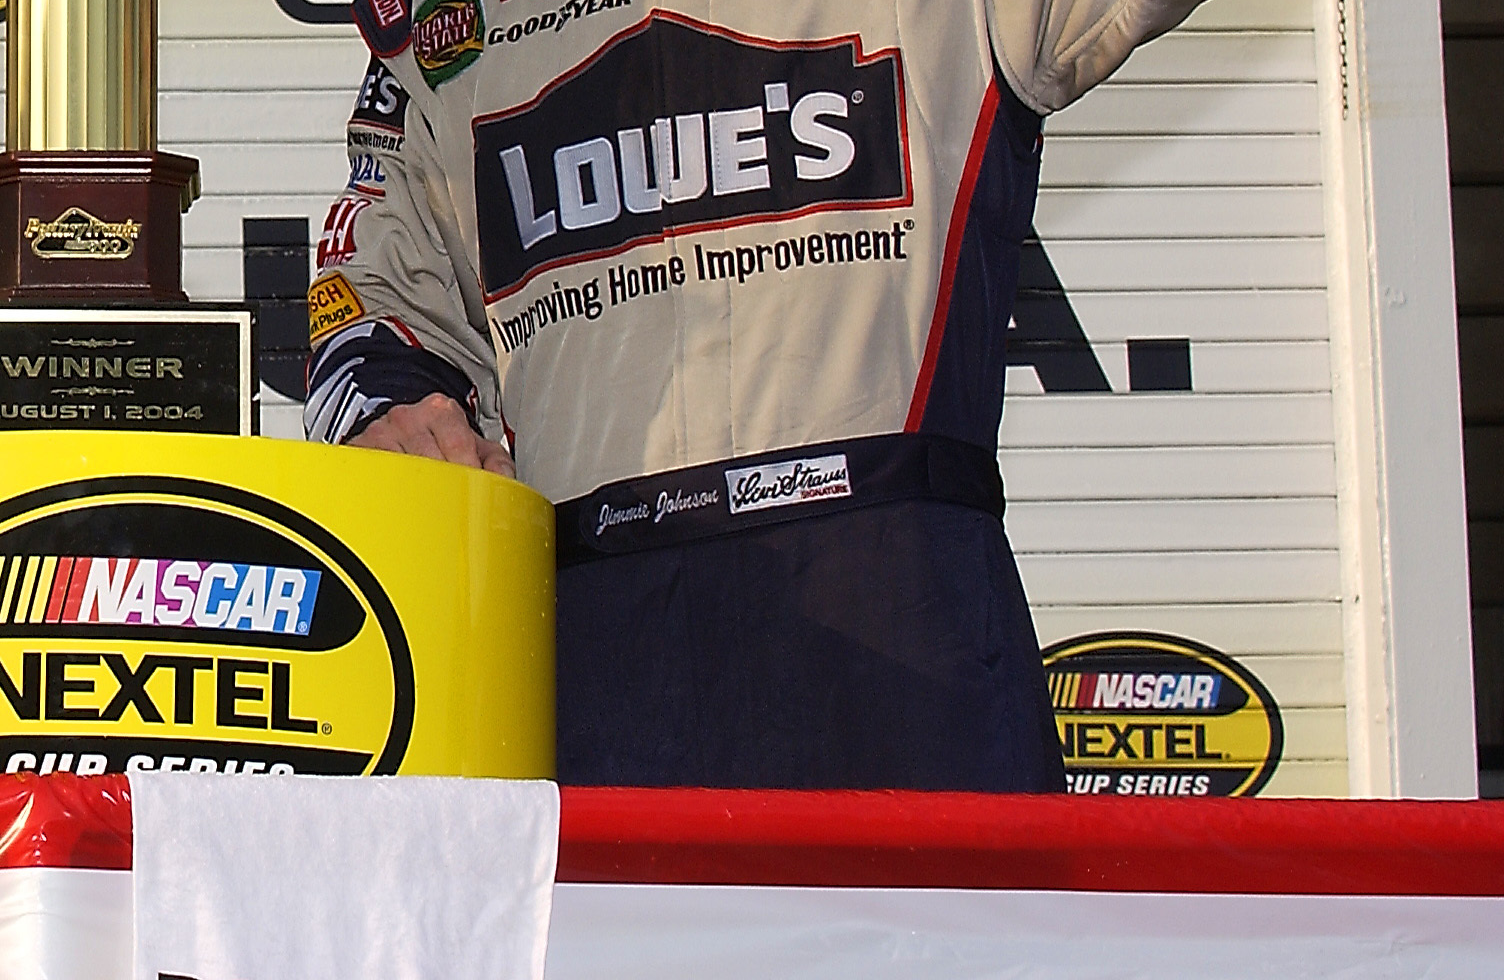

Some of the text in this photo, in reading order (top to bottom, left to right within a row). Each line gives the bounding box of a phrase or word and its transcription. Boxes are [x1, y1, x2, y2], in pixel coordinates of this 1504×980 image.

[421, 23, 471, 60] STATE
[499, 82, 856, 252] LOWE'S
[309, 283, 345, 313] SCH
[492, 222, 908, 353] Improving Home Improvement
[318, 303, 354, 328] Plugs
[1, 356, 184, 379] WINNER
[125, 405, 204, 420] 2004
[777, 463, 846, 498] Strauss
[799, 484, 848, 500] SIGNATURE
[596, 488, 720, 535] Jimmie Johnson
[79, 558, 305, 634] NASCAR
[1093, 674, 1214, 708] NASCAR
[1117, 775, 1210, 796] SERIES
